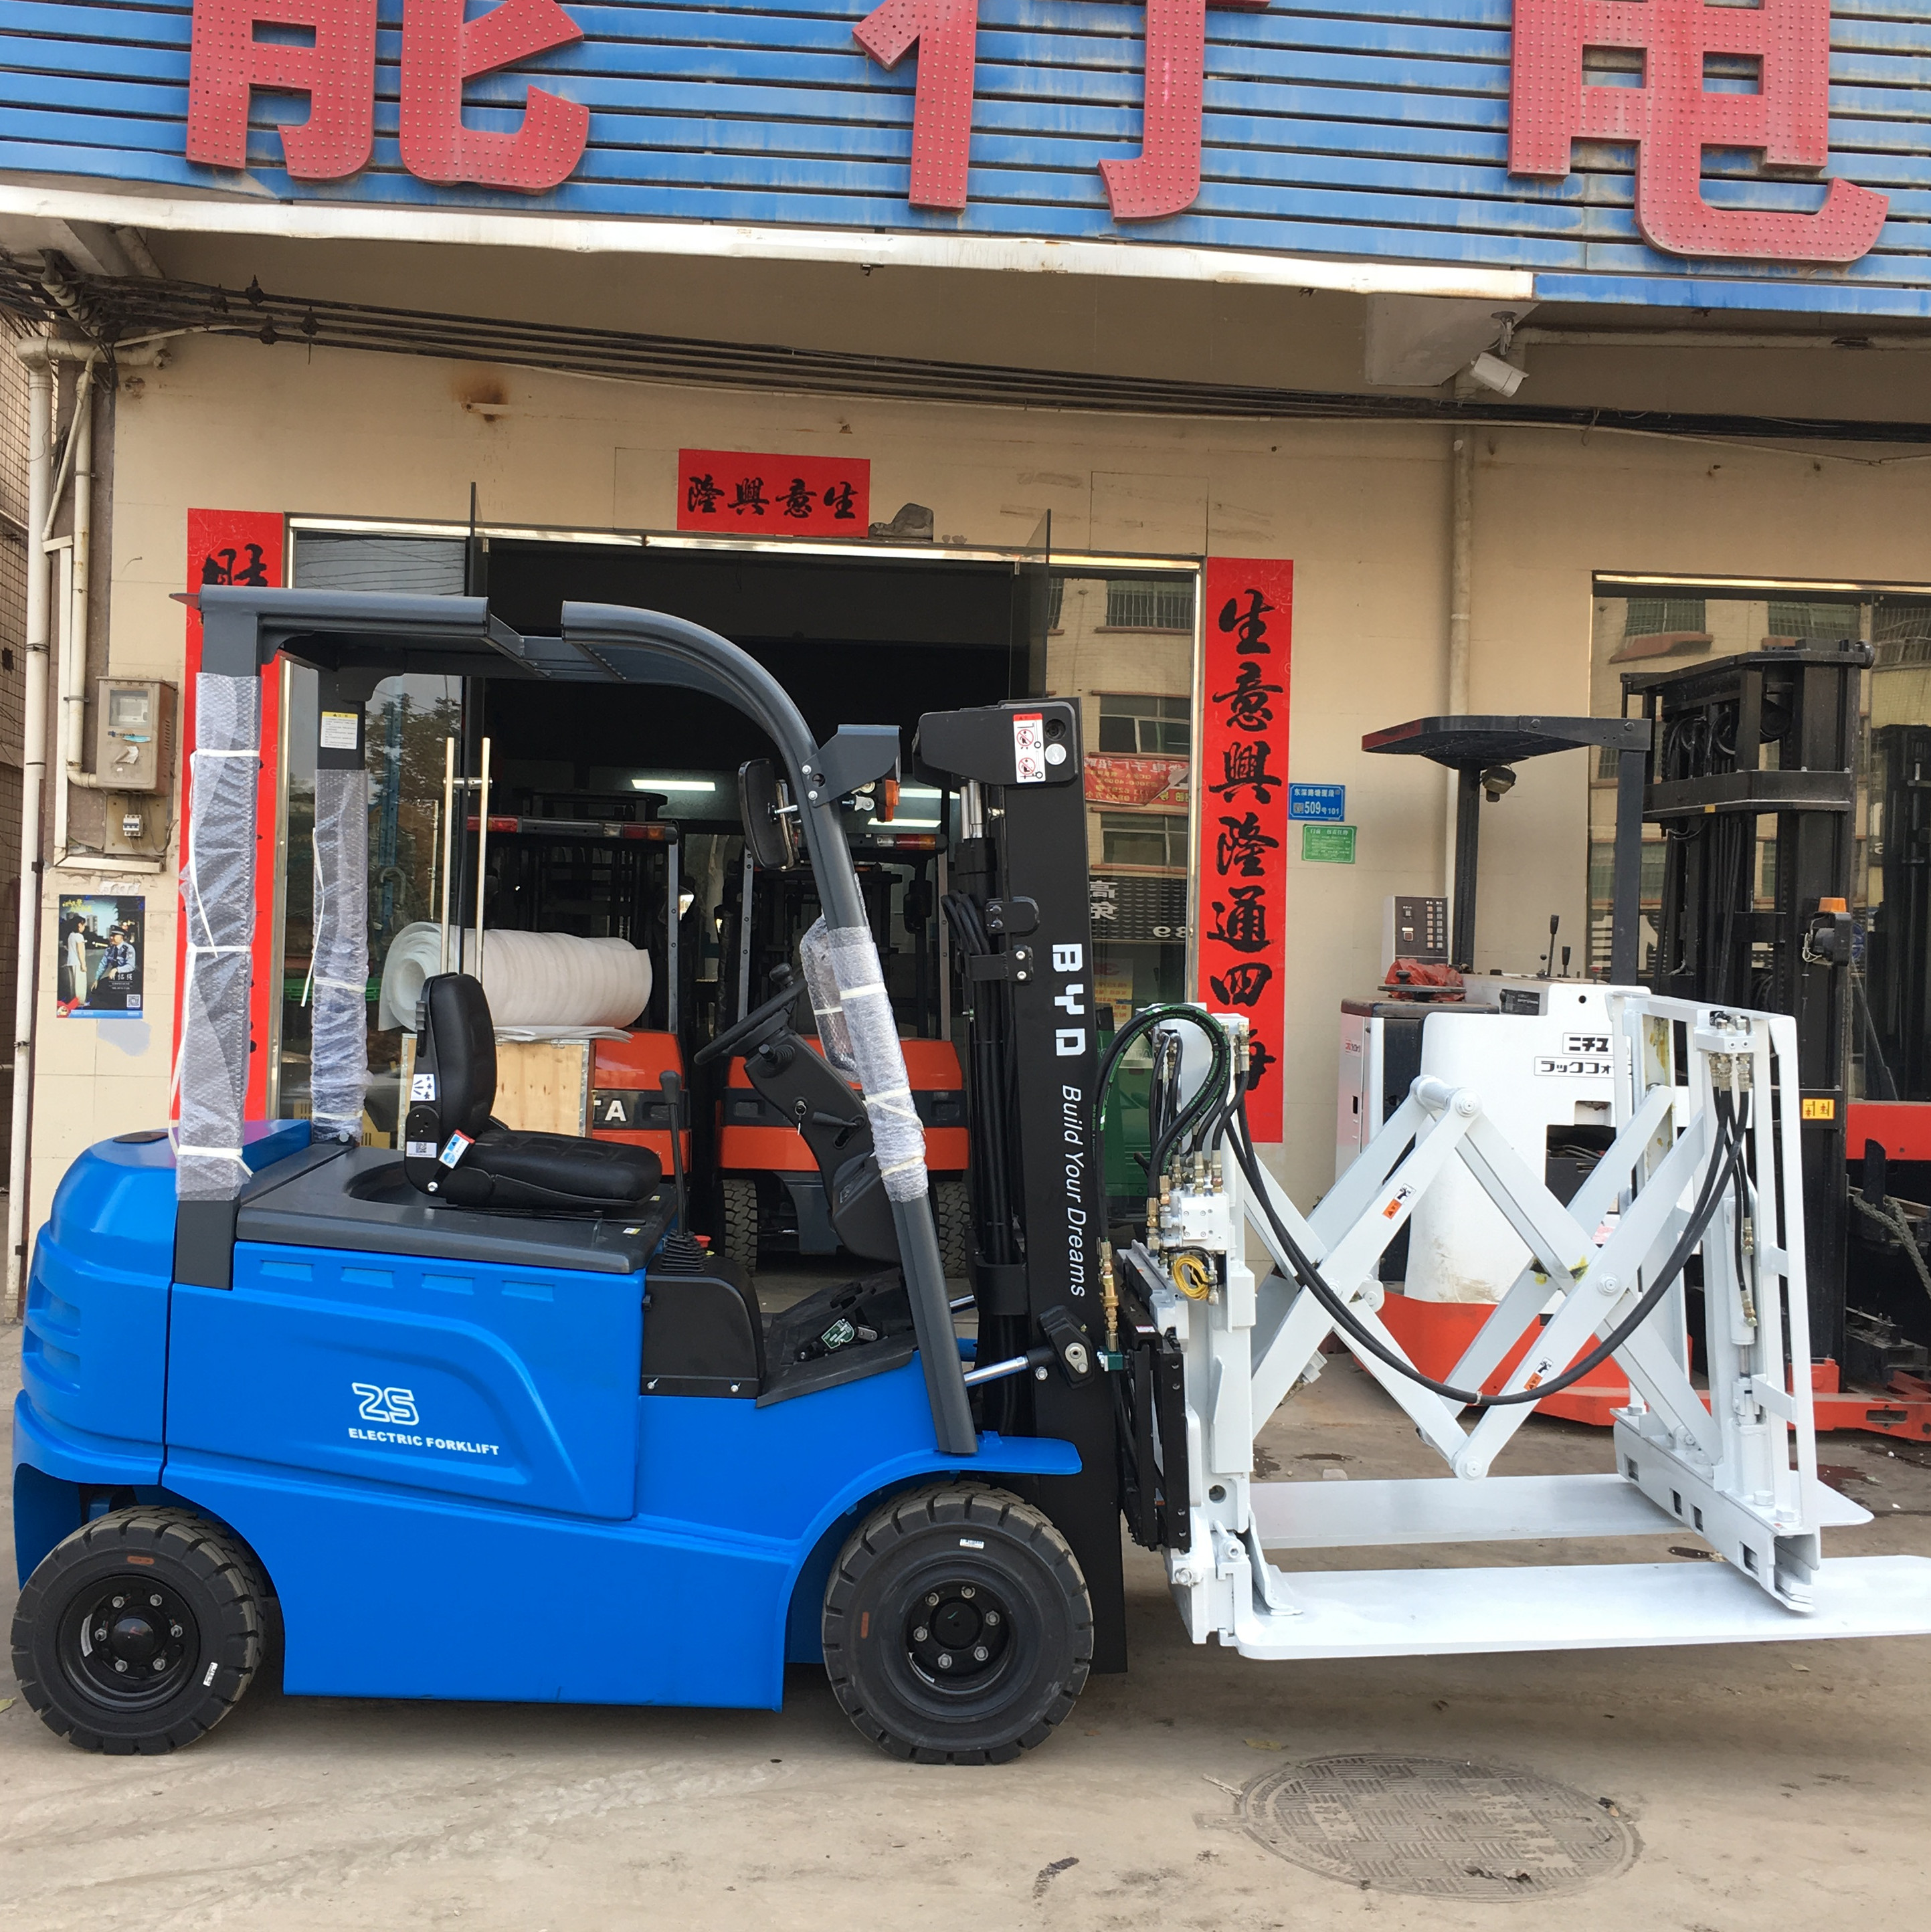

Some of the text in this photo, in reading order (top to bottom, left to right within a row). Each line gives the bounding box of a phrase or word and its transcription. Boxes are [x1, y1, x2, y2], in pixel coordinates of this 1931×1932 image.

[1052, 943, 1086, 1056] BYD
[1062, 1084, 1087, 1298] Build Your Dreams
[348, 1428, 499, 1456] ELECTRIC FORKLIFT
